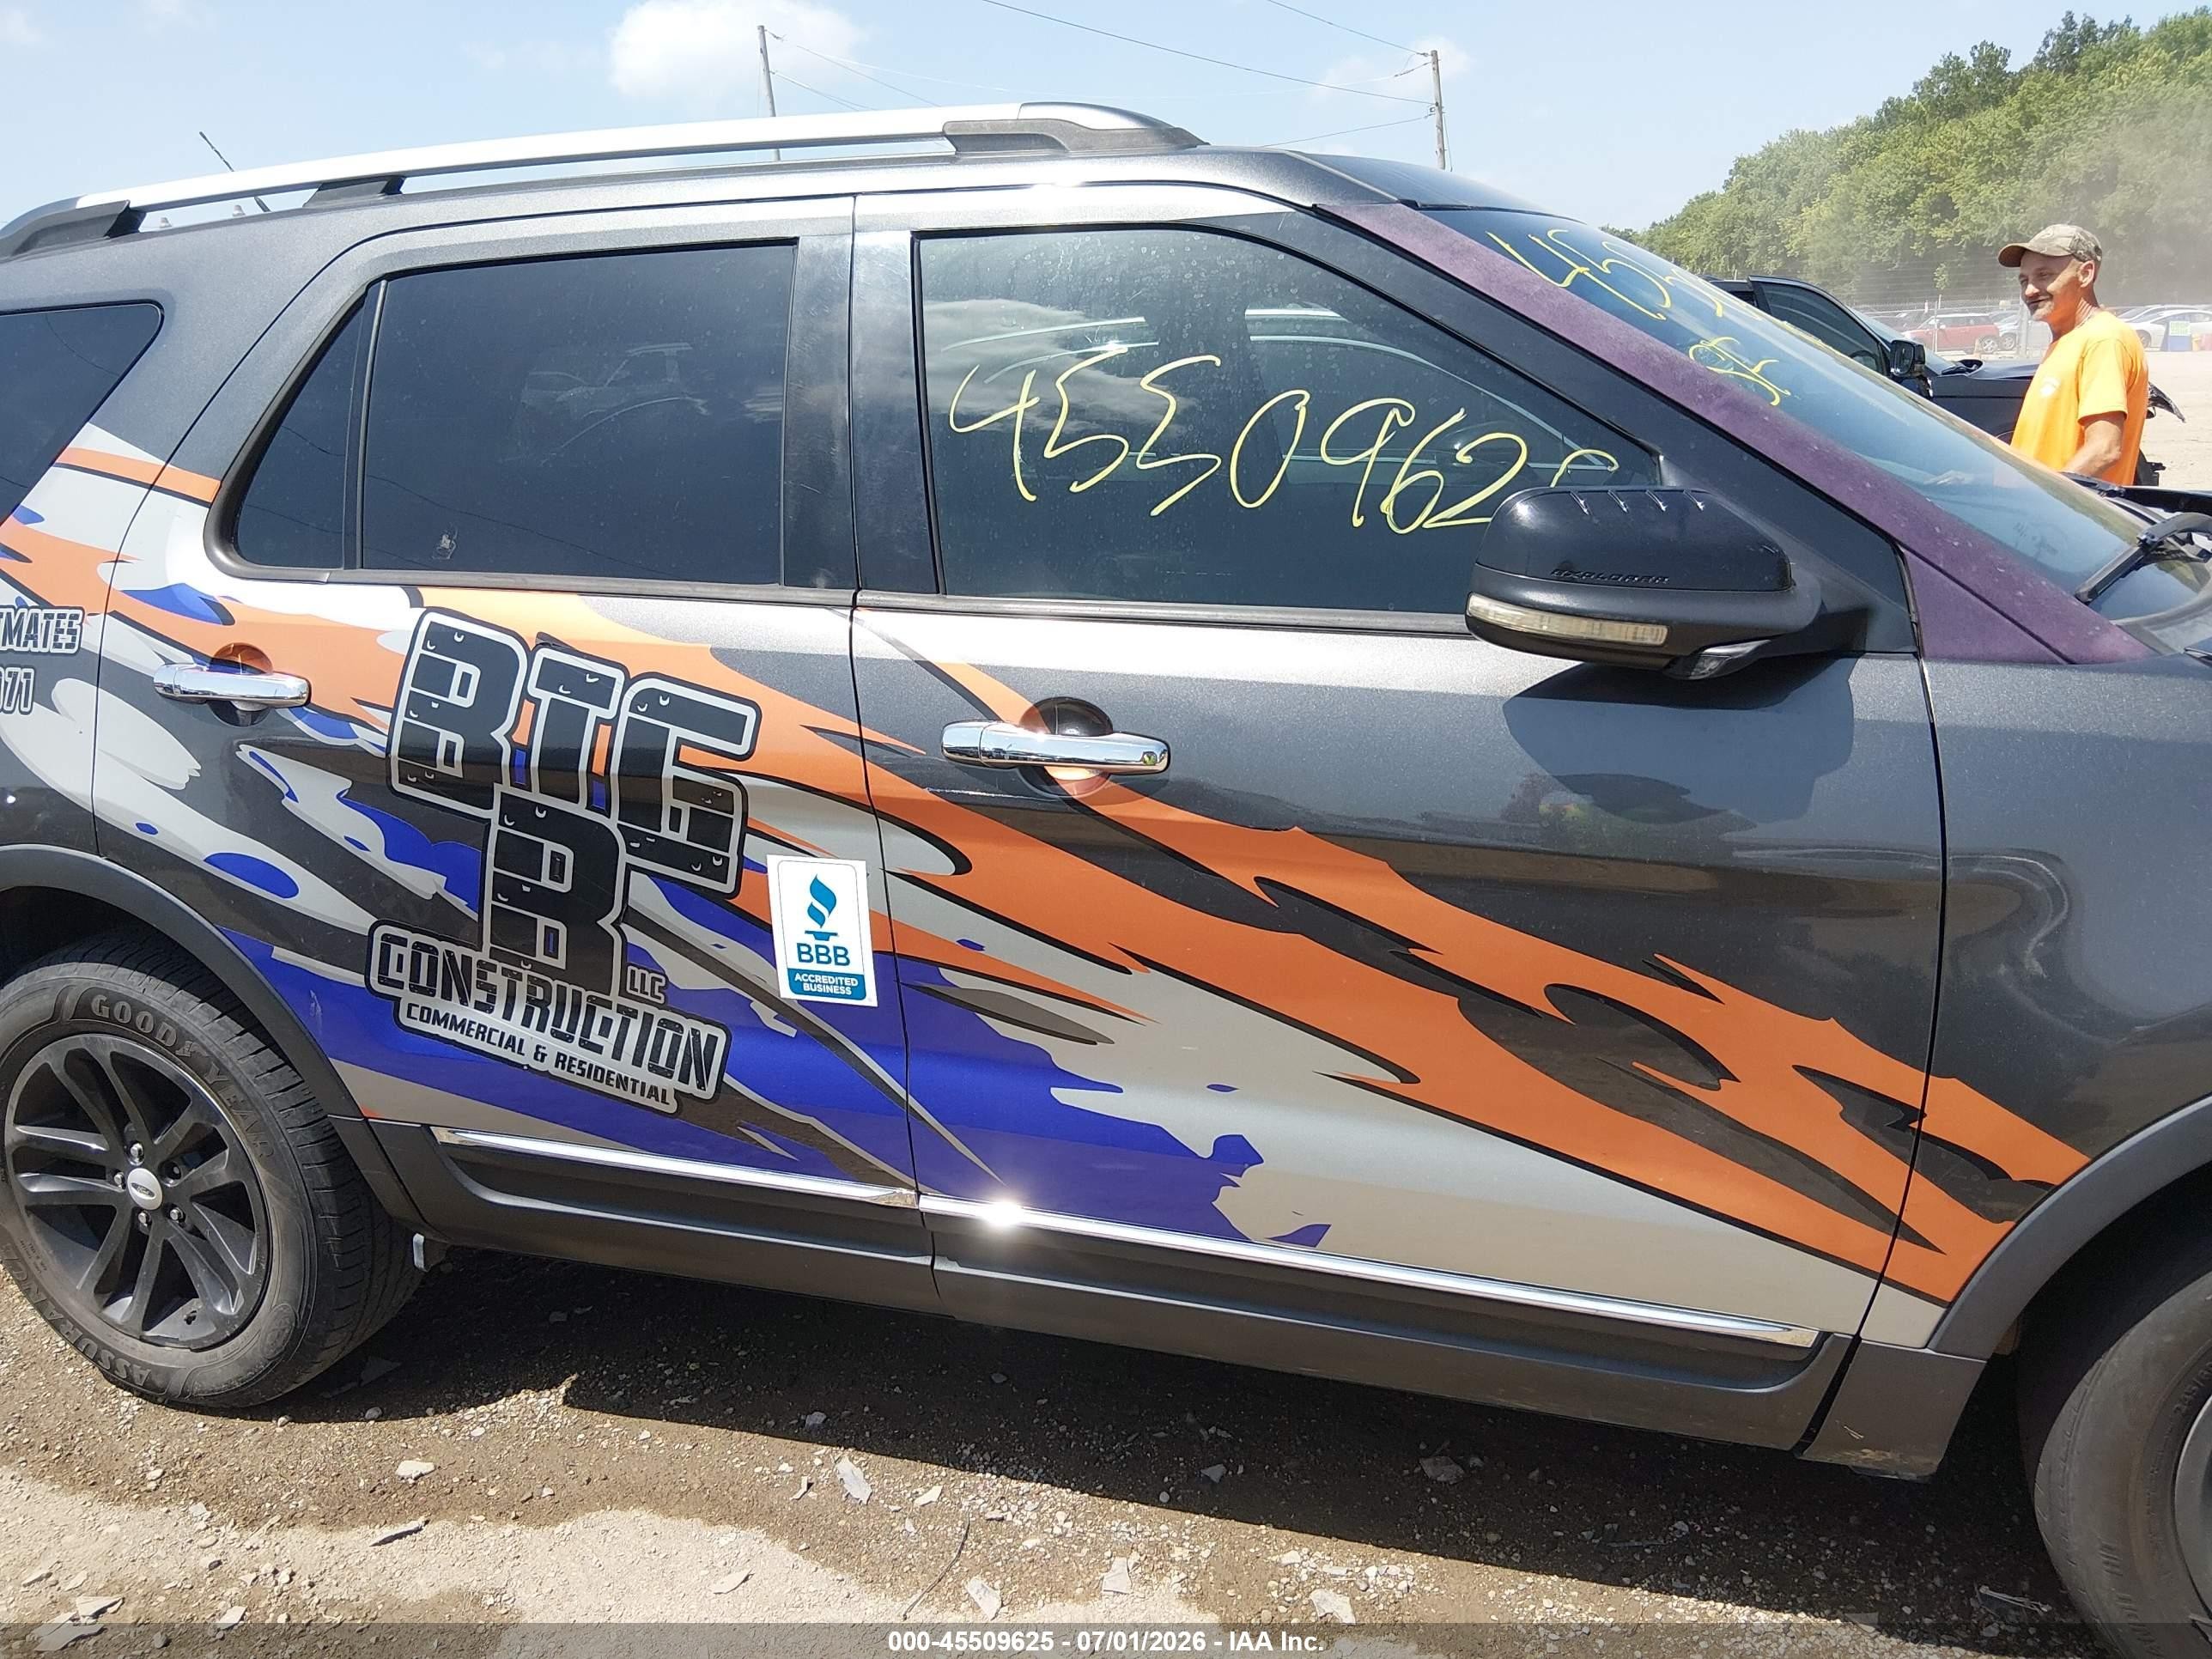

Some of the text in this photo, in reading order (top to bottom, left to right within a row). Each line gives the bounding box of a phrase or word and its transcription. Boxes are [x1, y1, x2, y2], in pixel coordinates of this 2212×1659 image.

[1549, 568, 1670, 585] EXPLORER
[484, 784, 628, 994] B
[796, 942, 851, 967] BBB
[628, 967, 665, 1003] LLC
[794, 972, 859, 988] ACCREDITED
[803, 982, 853, 996] BUSINESS
[377, 933, 719, 1091] CONSTRUCTION
[405, 1002, 671, 1106] COMMERCIAL & RESIDENTIAL
